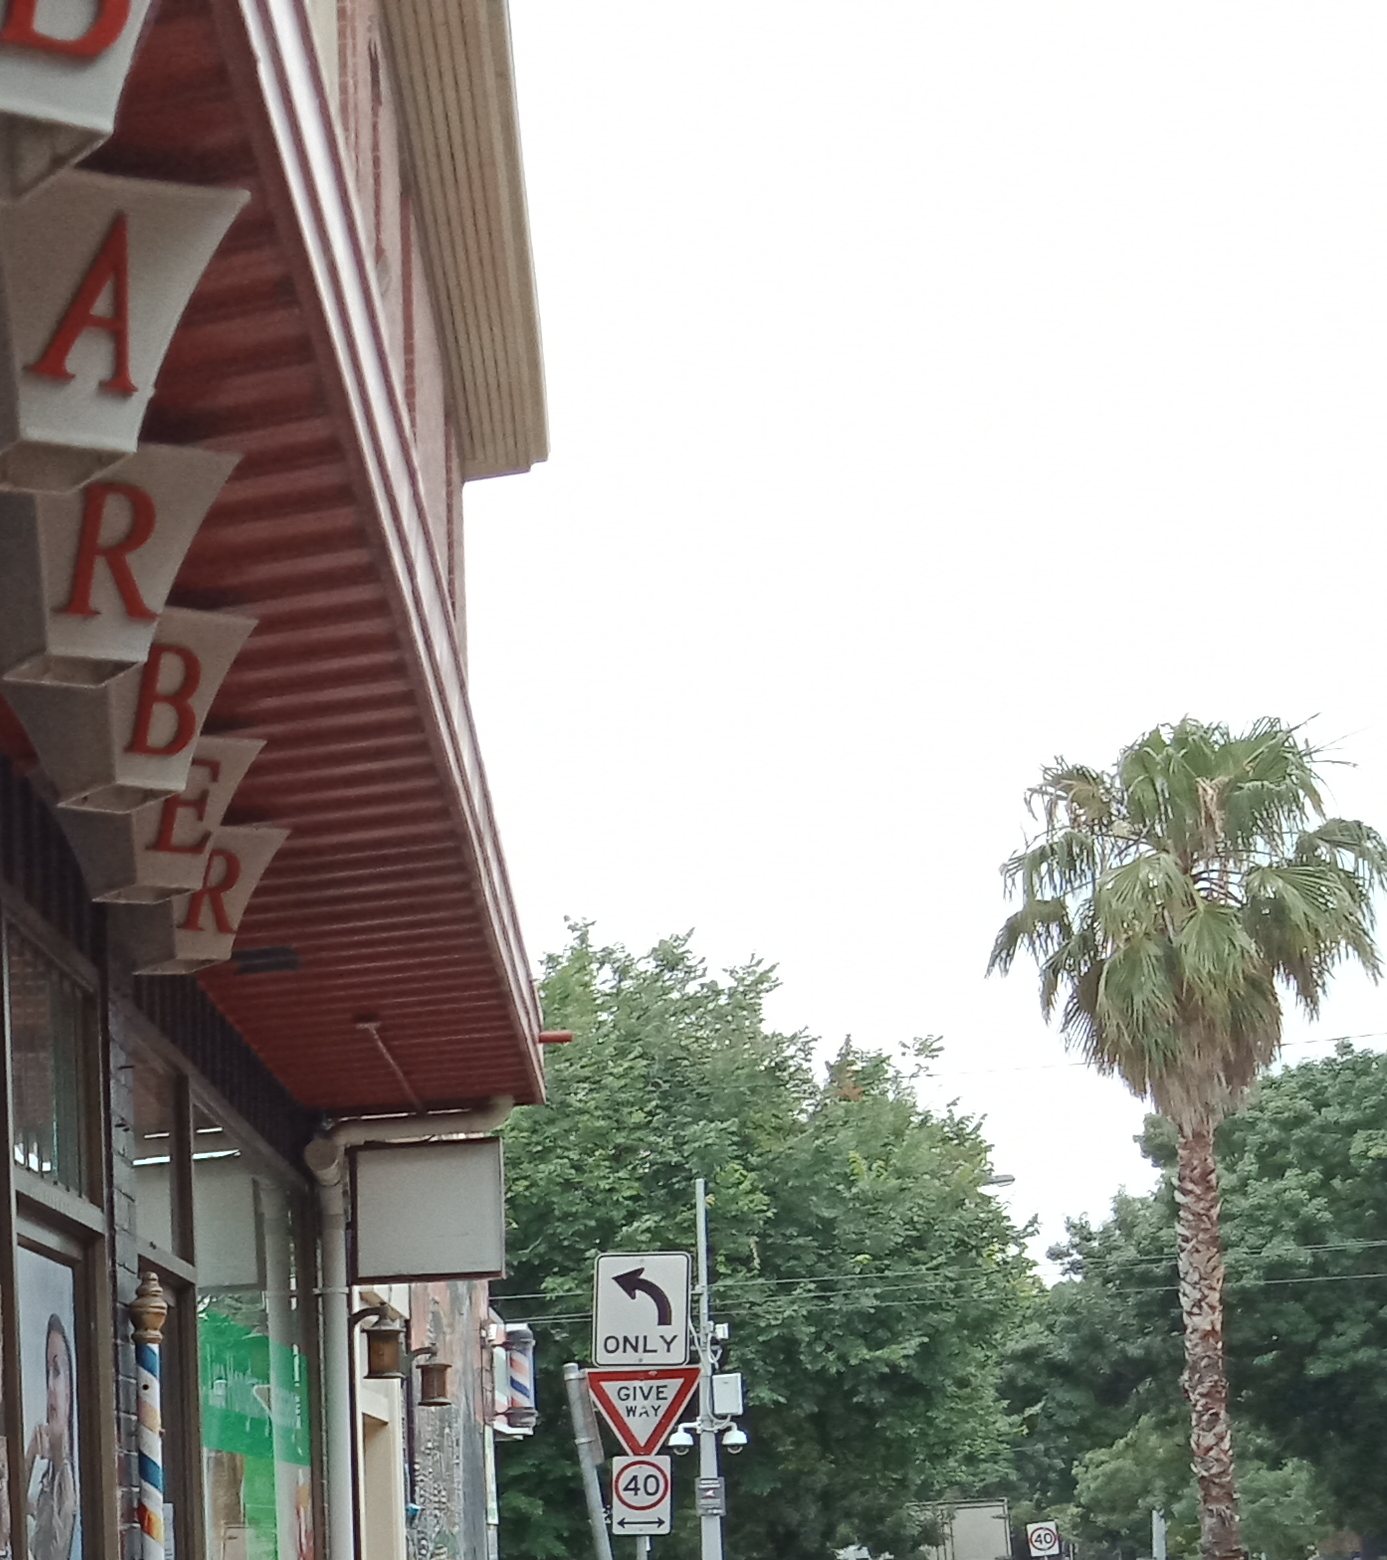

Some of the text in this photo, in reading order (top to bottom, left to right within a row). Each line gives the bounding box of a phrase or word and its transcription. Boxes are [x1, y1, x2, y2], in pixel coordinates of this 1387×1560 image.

[603, 1334, 678, 1354] ONLY
[617, 1385, 668, 1402] GIVE
[625, 1405, 662, 1418] WAY
[623, 1474, 661, 1497] 40
[1034, 1532, 1053, 1545] 40
